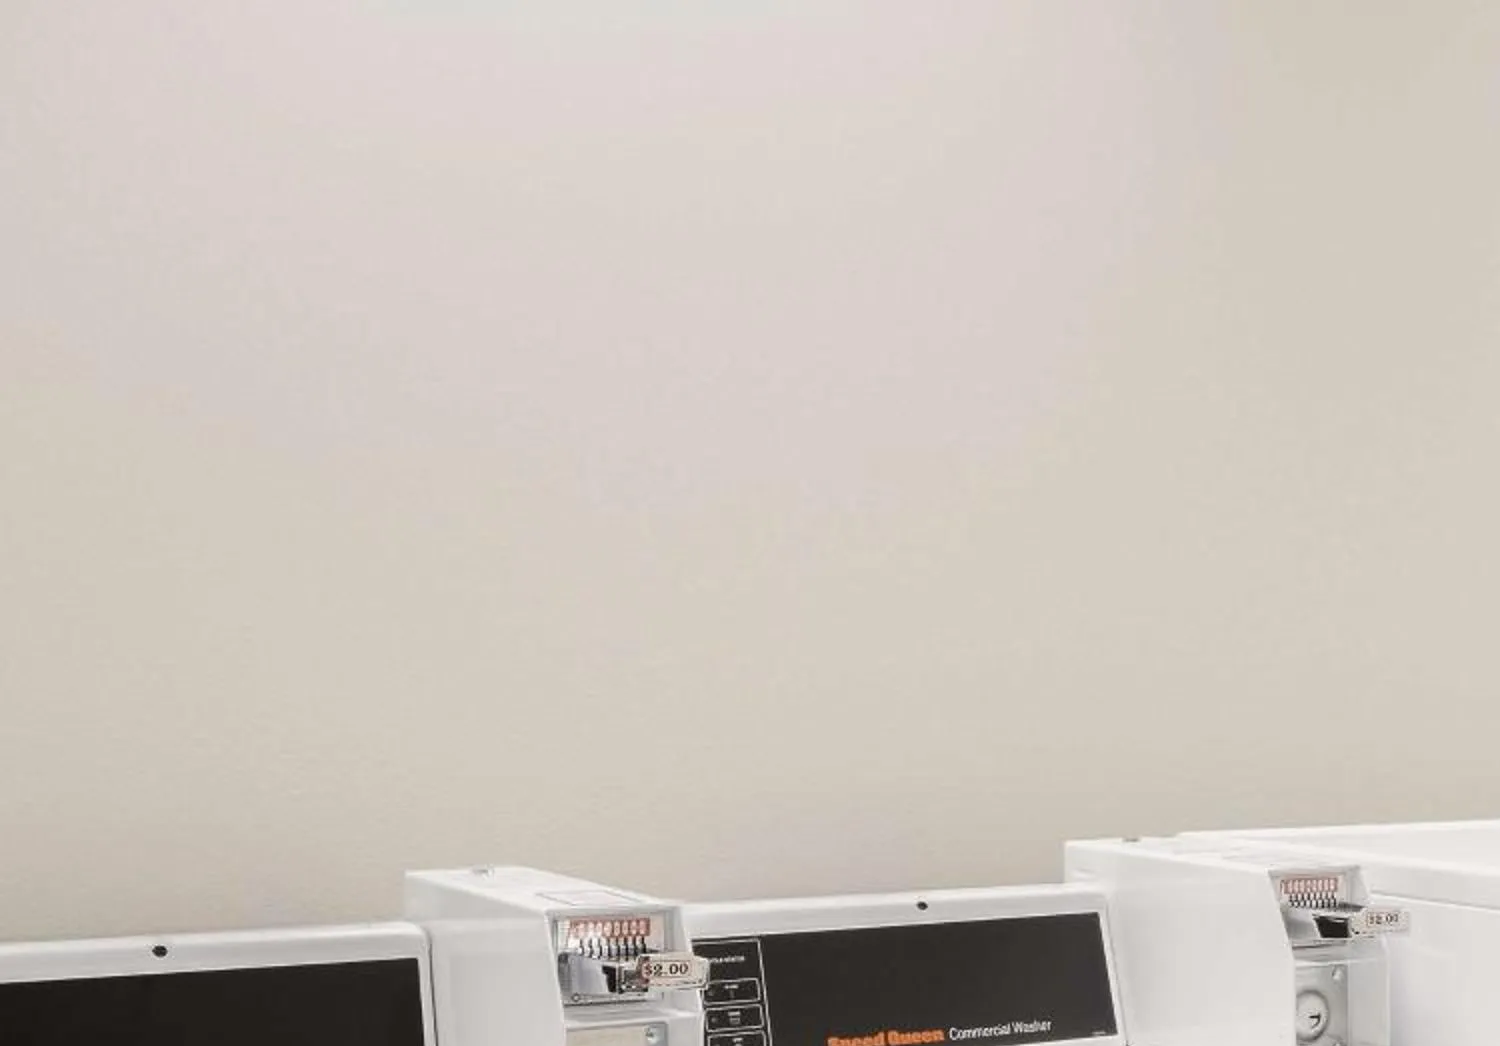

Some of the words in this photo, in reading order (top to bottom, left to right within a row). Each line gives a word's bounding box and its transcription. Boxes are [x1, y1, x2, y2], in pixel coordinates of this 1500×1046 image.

[643, 962, 690, 977] $2.00
[887, 1028, 945, 1046] Queen
[949, 1022, 1011, 1041] Commercial
[1012, 1019, 1052, 1034] Washer
